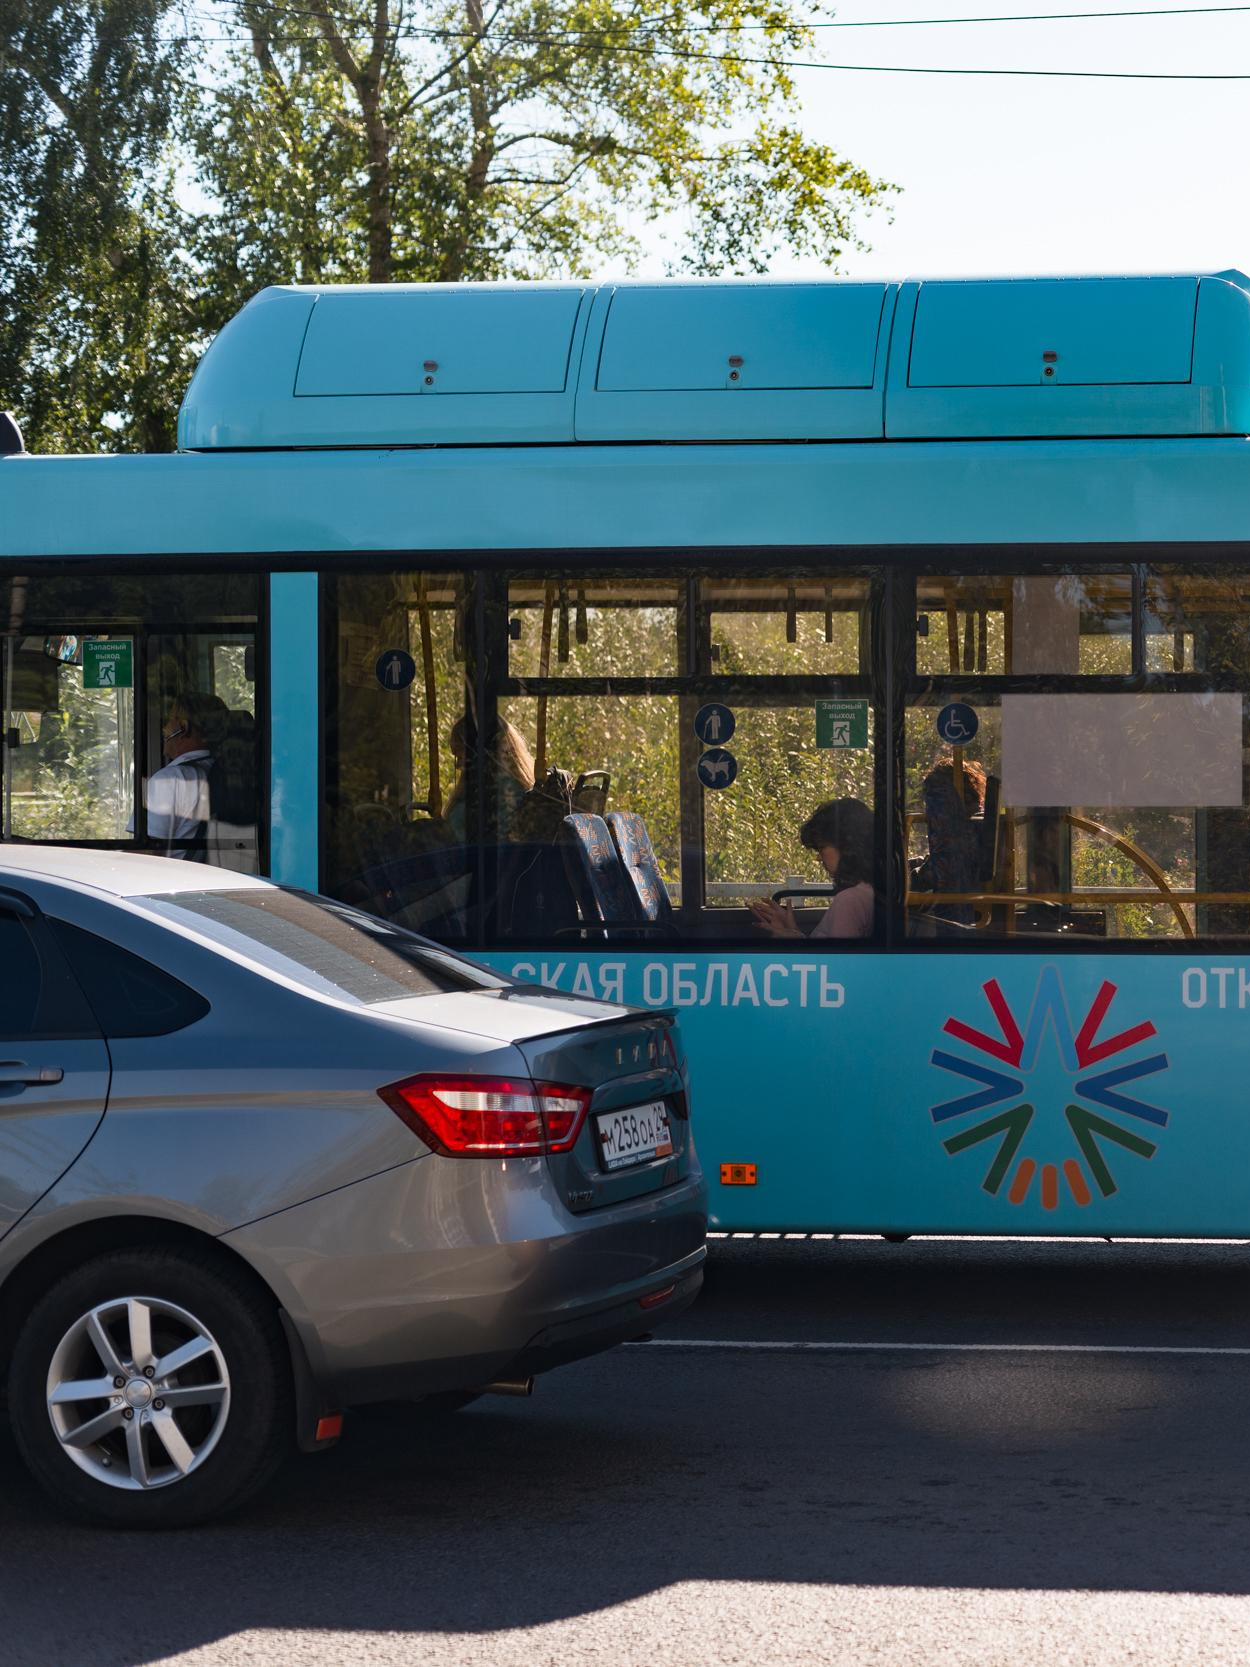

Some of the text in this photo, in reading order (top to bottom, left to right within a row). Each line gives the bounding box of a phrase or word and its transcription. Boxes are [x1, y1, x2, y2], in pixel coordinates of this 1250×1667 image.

[88, 643, 127, 651] Запасный
[95, 653, 121, 661] выход
[822, 702, 862, 710] Запасный
[643, 962, 845, 1008] ОБЛАСТЬ
